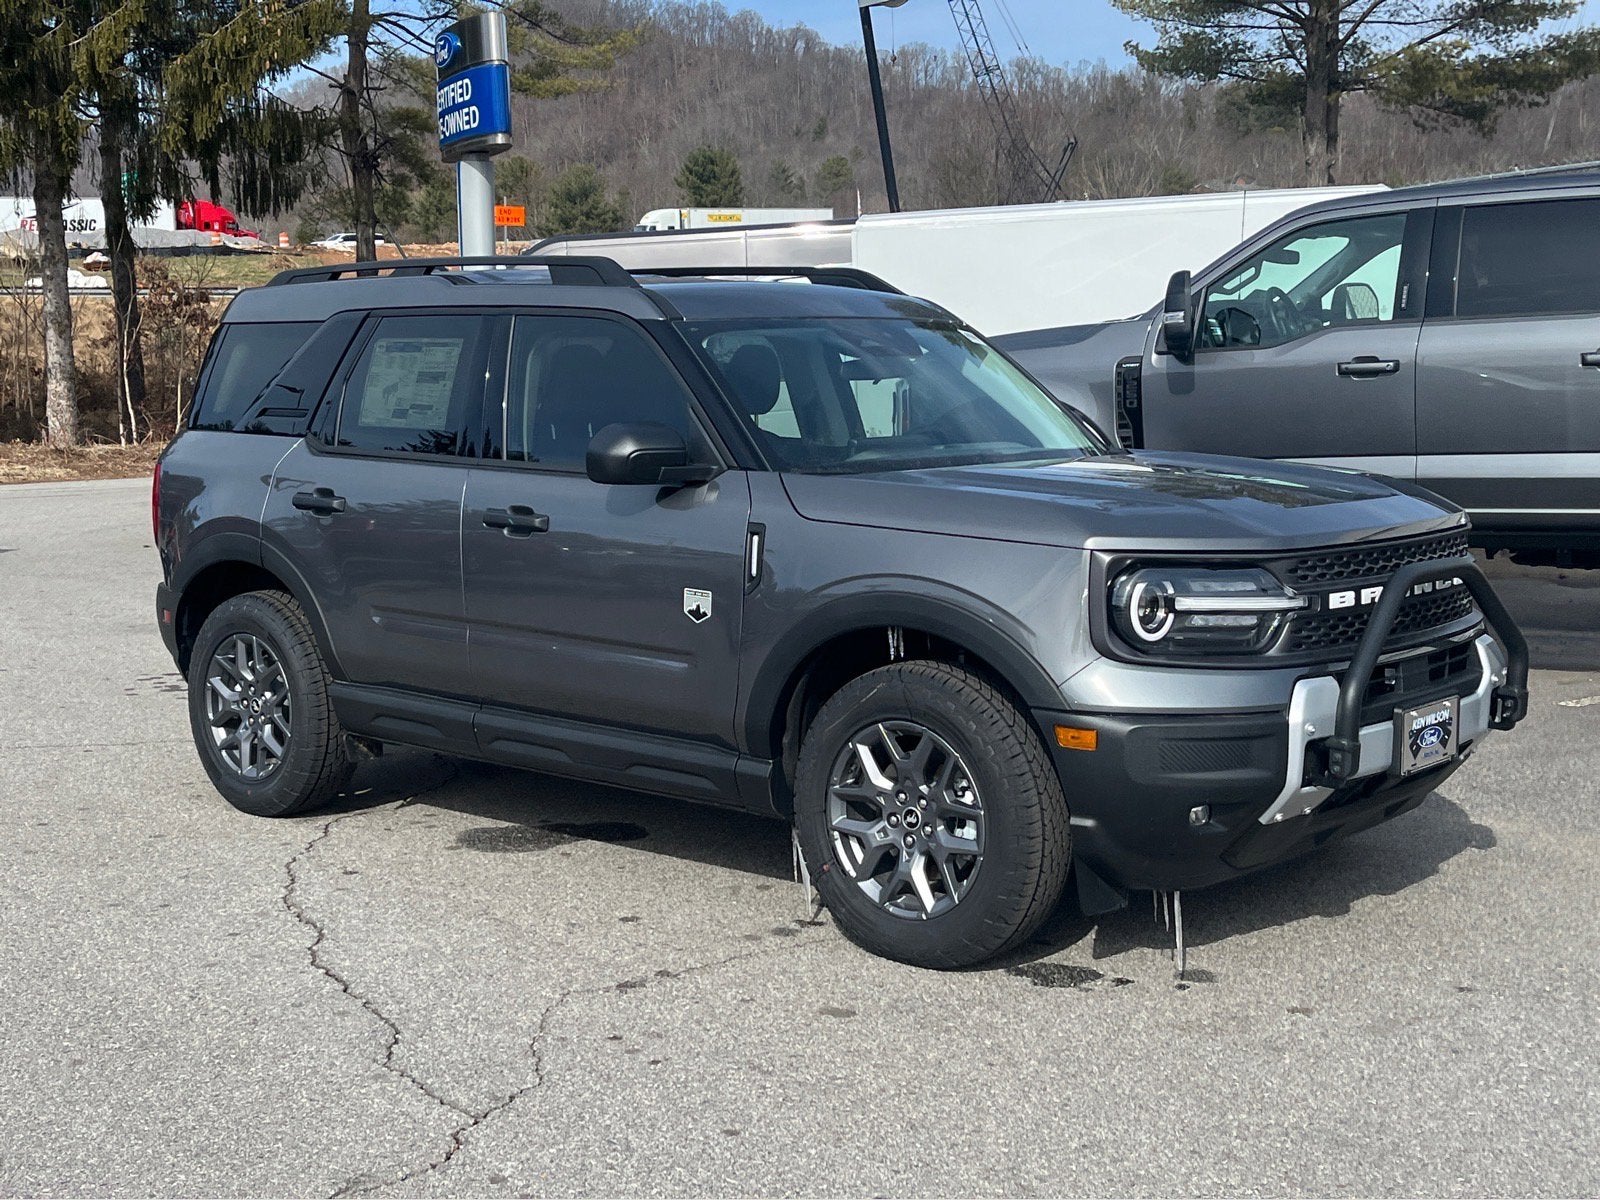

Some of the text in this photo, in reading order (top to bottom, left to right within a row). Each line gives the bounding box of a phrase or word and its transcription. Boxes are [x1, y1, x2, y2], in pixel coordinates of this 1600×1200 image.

[437, 78, 472, 112] ERTIFIED
[439, 105, 480, 139] E-OWNED
[499, 208, 511, 216] END
[21, 218, 97, 232] RE ASSIC
[1328, 577, 1464, 610] BRNC
[1411, 709, 1450, 731] KEN WILSON
[1422, 729, 1440, 746] Ford
